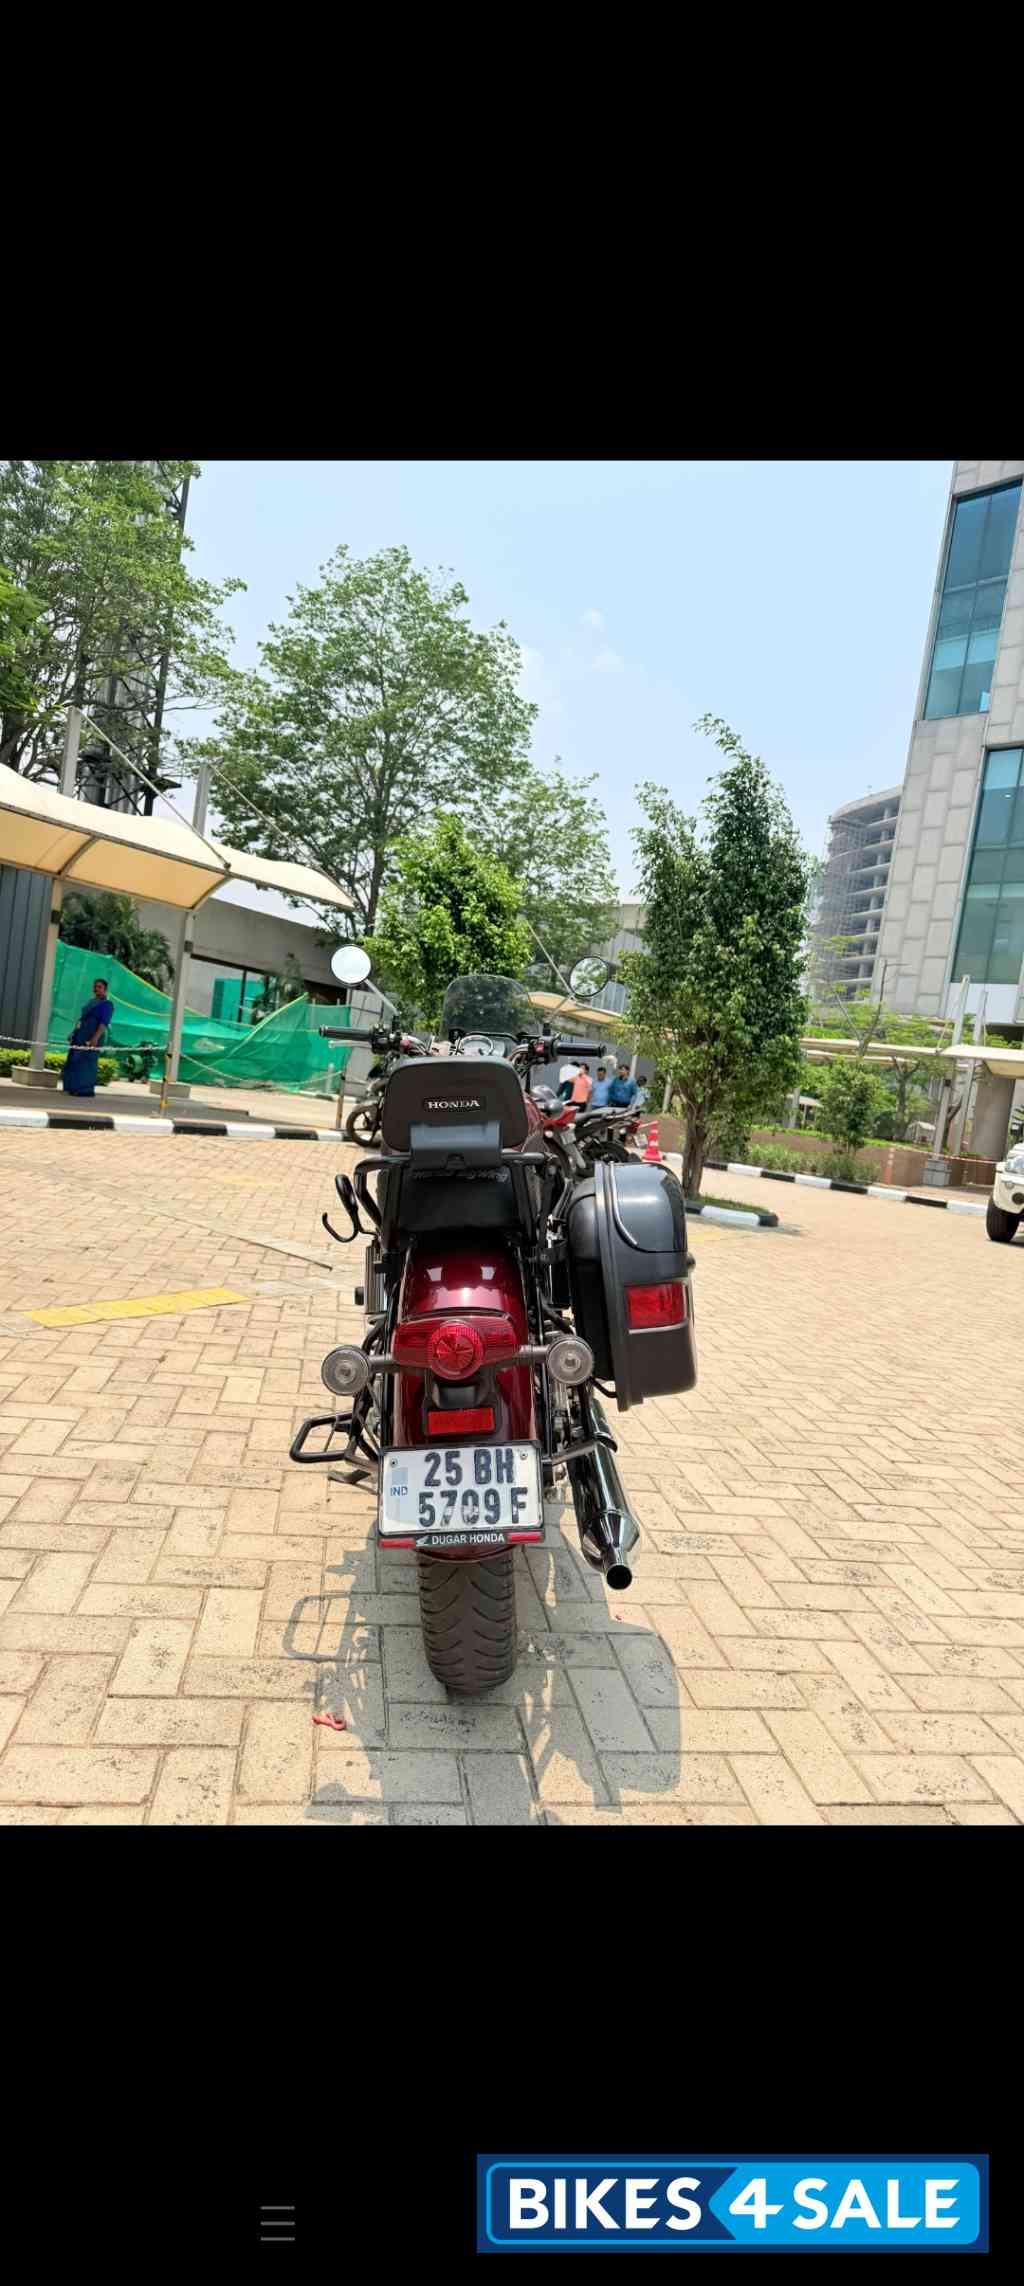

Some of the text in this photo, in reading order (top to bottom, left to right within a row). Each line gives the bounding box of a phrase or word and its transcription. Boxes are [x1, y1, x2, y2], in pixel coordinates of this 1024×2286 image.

[427, 1099, 481, 1109] HONDA
[424, 1448, 514, 1487] 25 BH
[390, 1486, 408, 1496] IND
[418, 1487, 528, 1527] 5709 F
[431, 1533, 505, 1545] DUGAR HONDA
